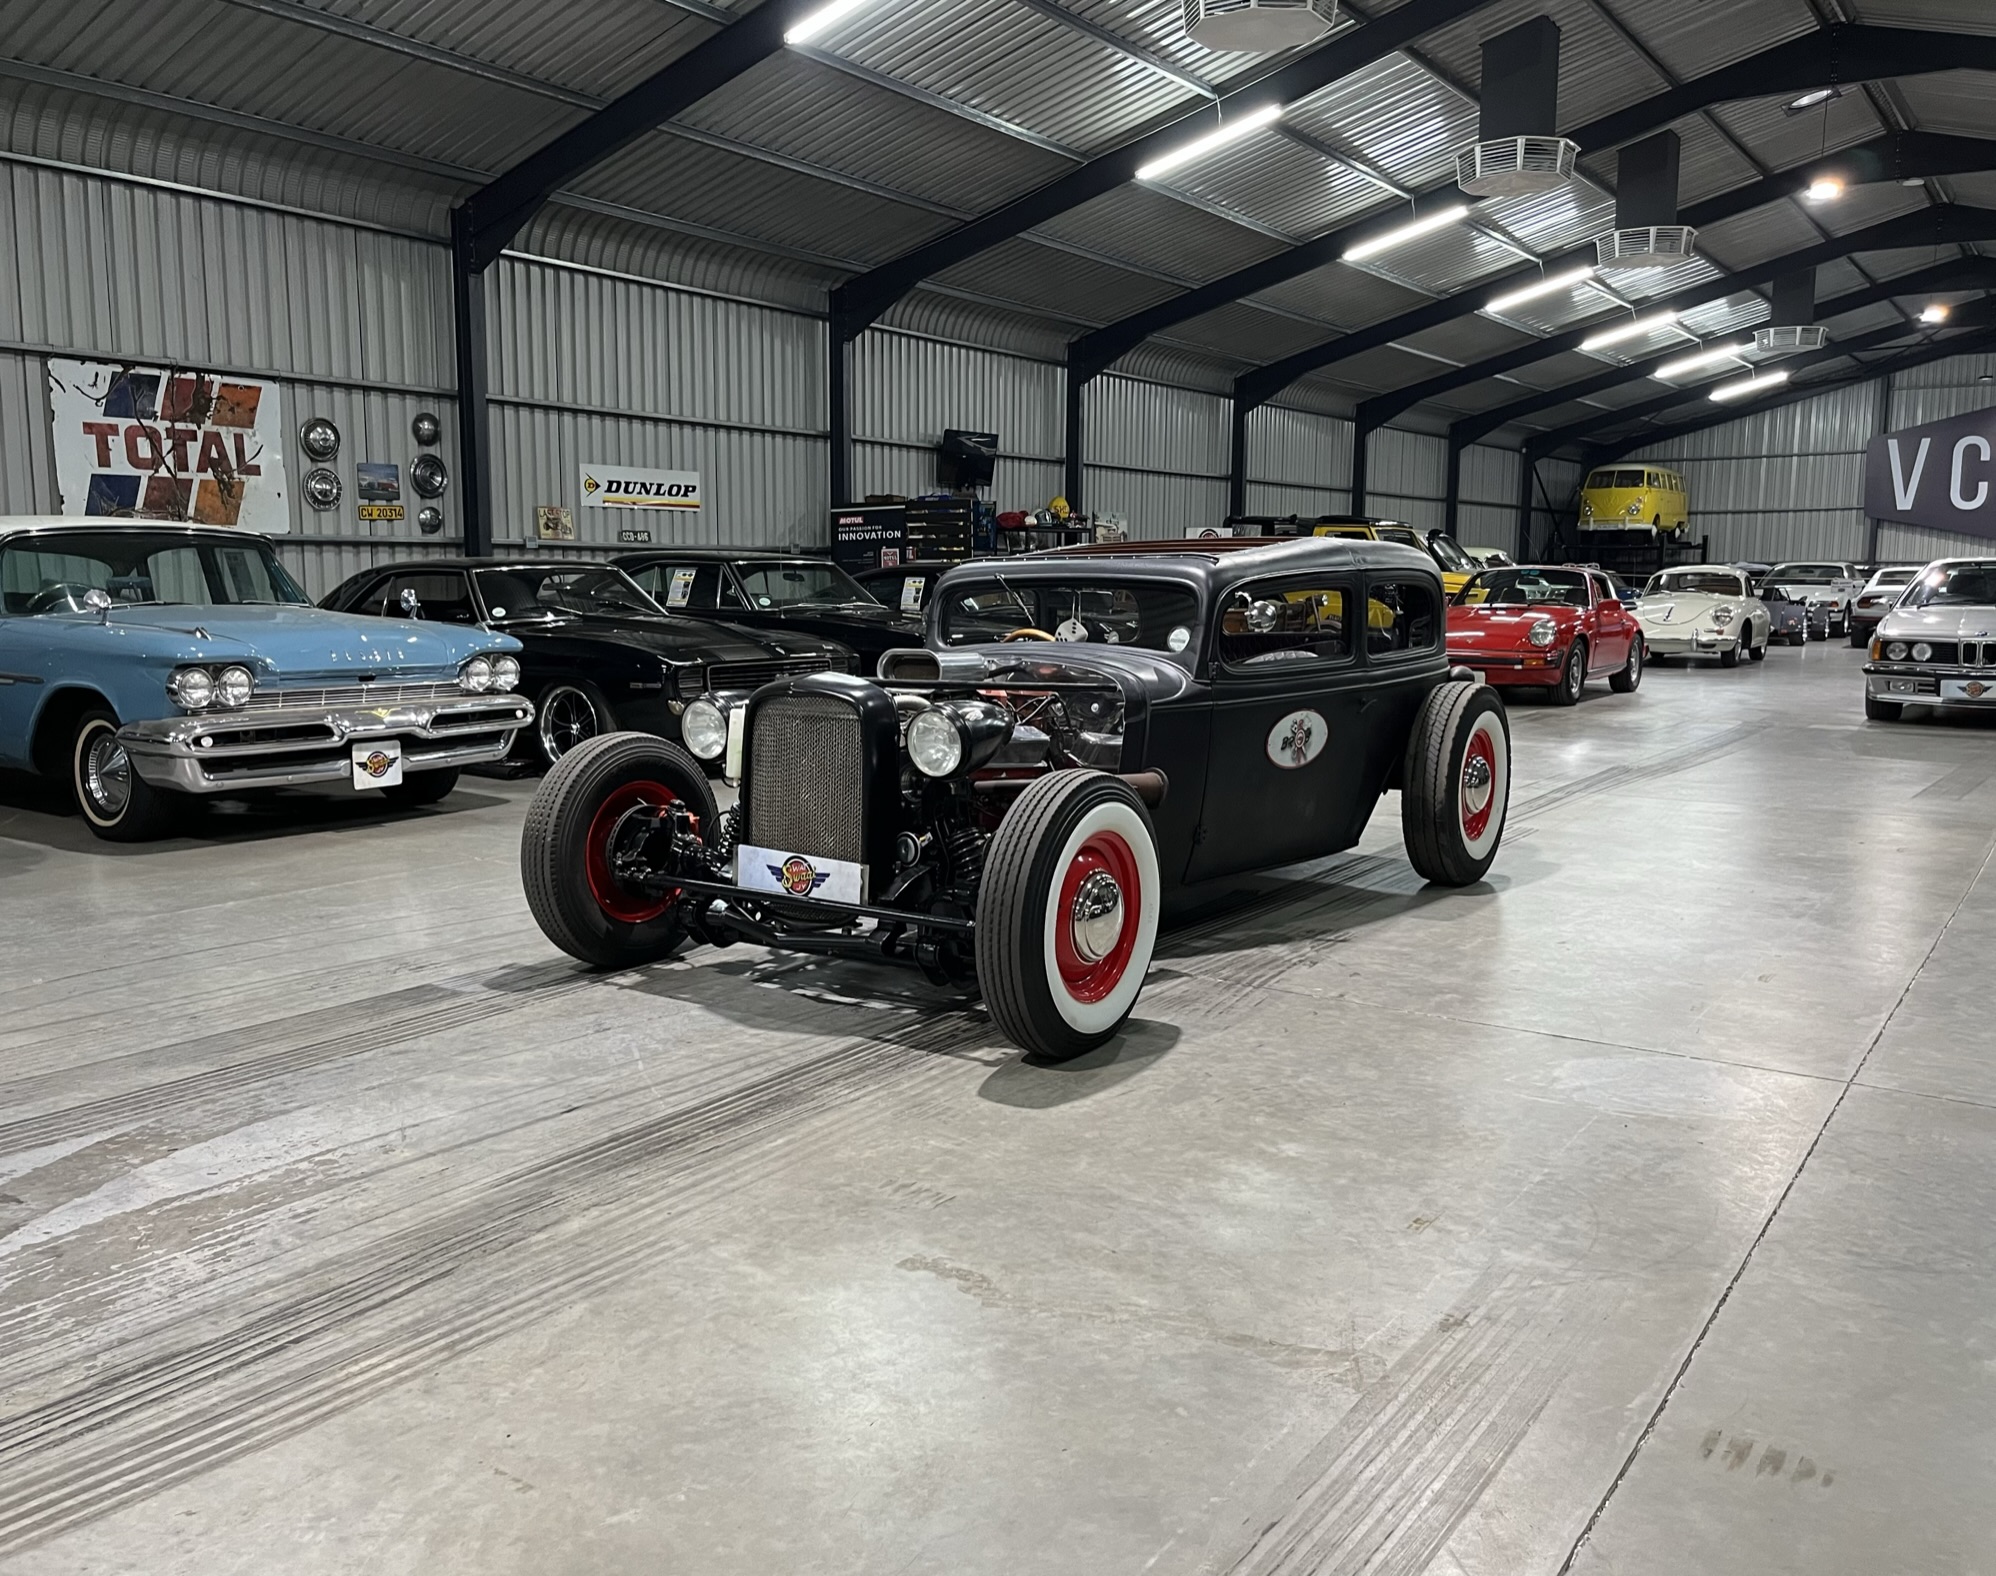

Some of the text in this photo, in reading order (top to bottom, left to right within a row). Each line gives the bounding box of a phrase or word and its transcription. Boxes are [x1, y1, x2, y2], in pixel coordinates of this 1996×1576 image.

[82, 421, 262, 477] TOTAL
[604, 479, 697, 498] DUNLOP
[839, 515, 864, 525] MOTUL
[838, 530, 902, 541] INNOVATION
